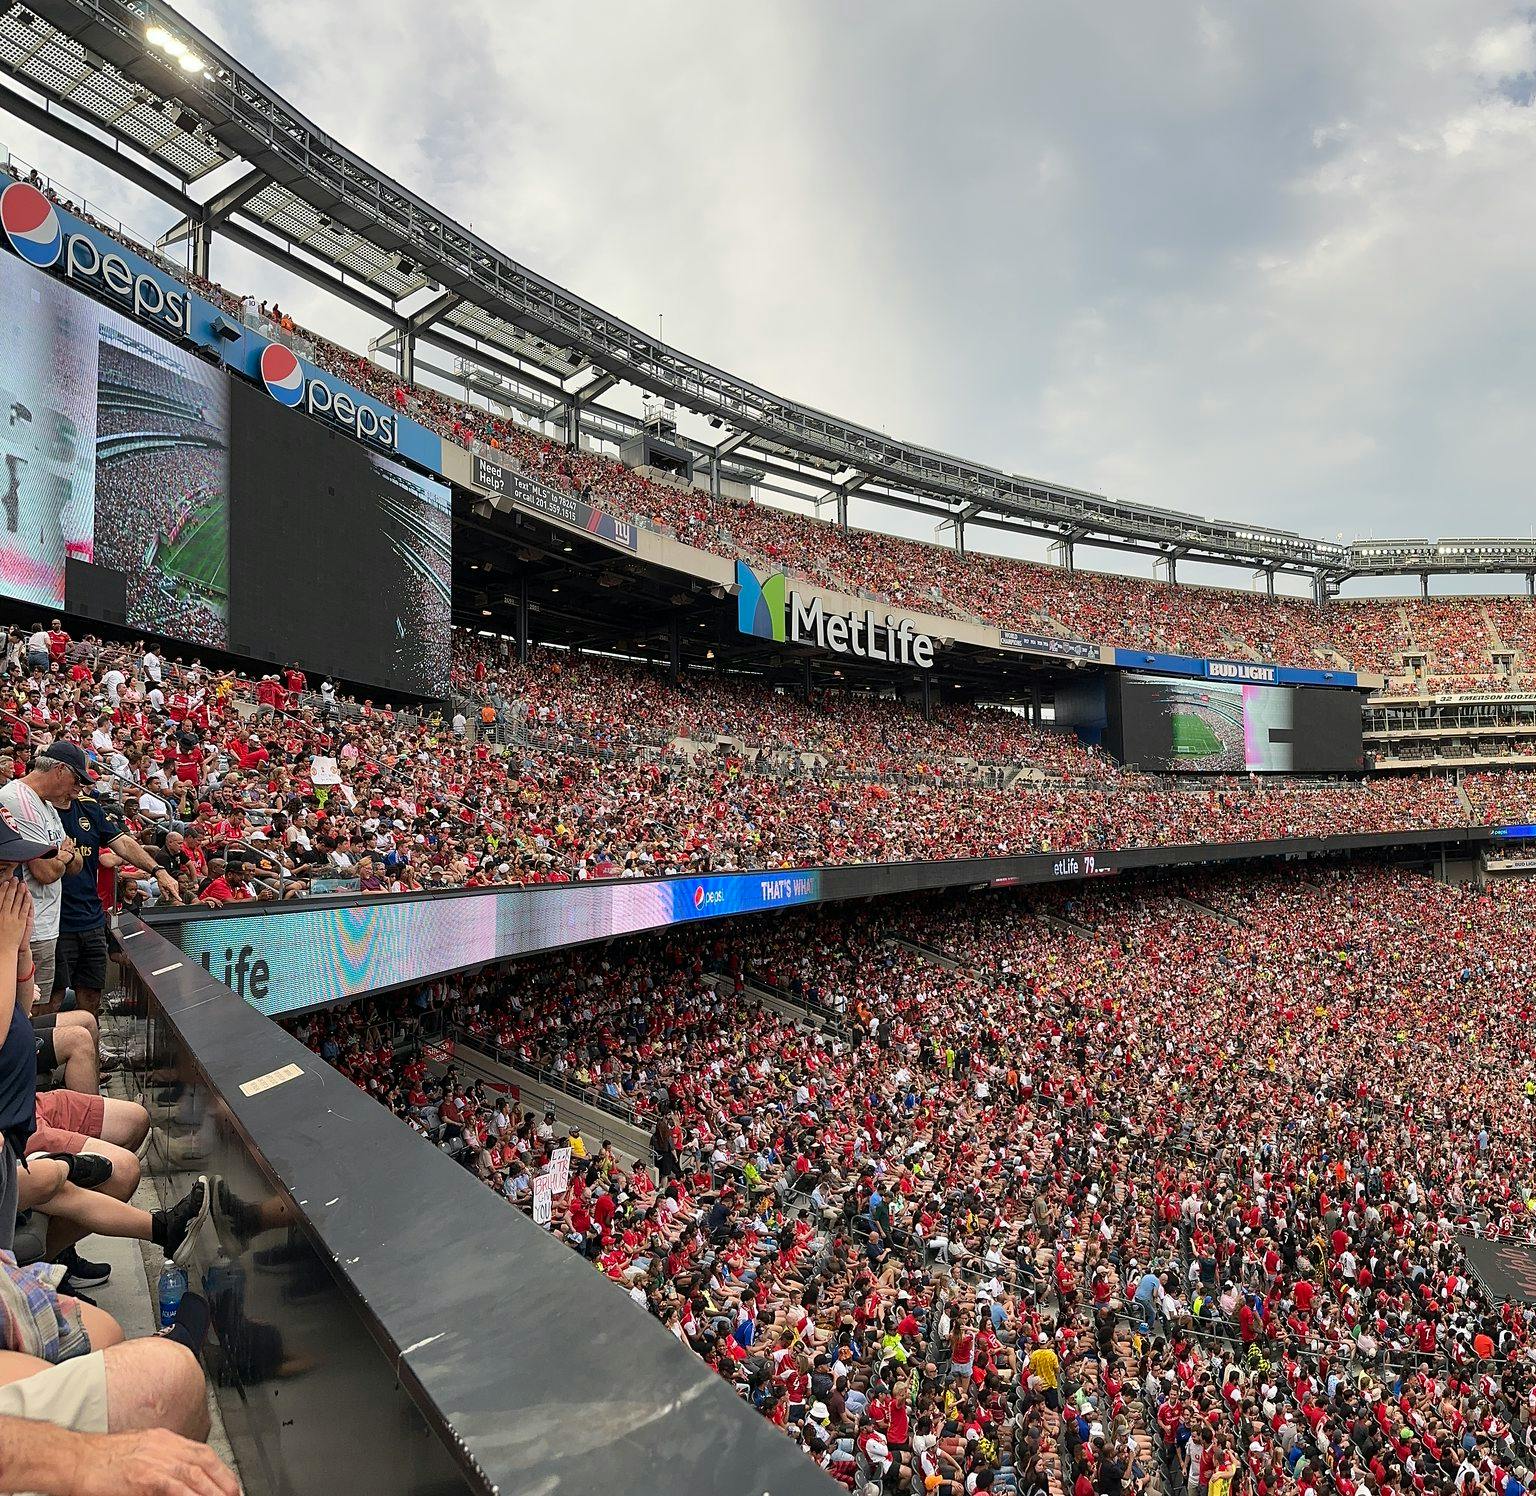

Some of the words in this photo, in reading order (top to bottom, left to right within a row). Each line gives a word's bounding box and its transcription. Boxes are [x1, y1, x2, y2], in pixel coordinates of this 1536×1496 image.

[66, 234, 192, 335] pepsi
[307, 378, 399, 449] pepsi
[479, 459, 502, 477] Need
[479, 470, 505, 491] Help?
[514, 477, 530, 490] Text
[551, 494, 558, 503] to
[558, 496, 577, 511] 78247
[514, 490, 522, 498] or
[522, 491, 535, 503] call
[790, 590, 934, 669] MetLife
[1210, 662, 1238, 677] BUD
[1238, 664, 1274, 681] LIGHT
[705, 888, 724, 906] pepsi
[761, 878, 791, 900] THAT'S
[793, 877, 815, 896] WHAT
